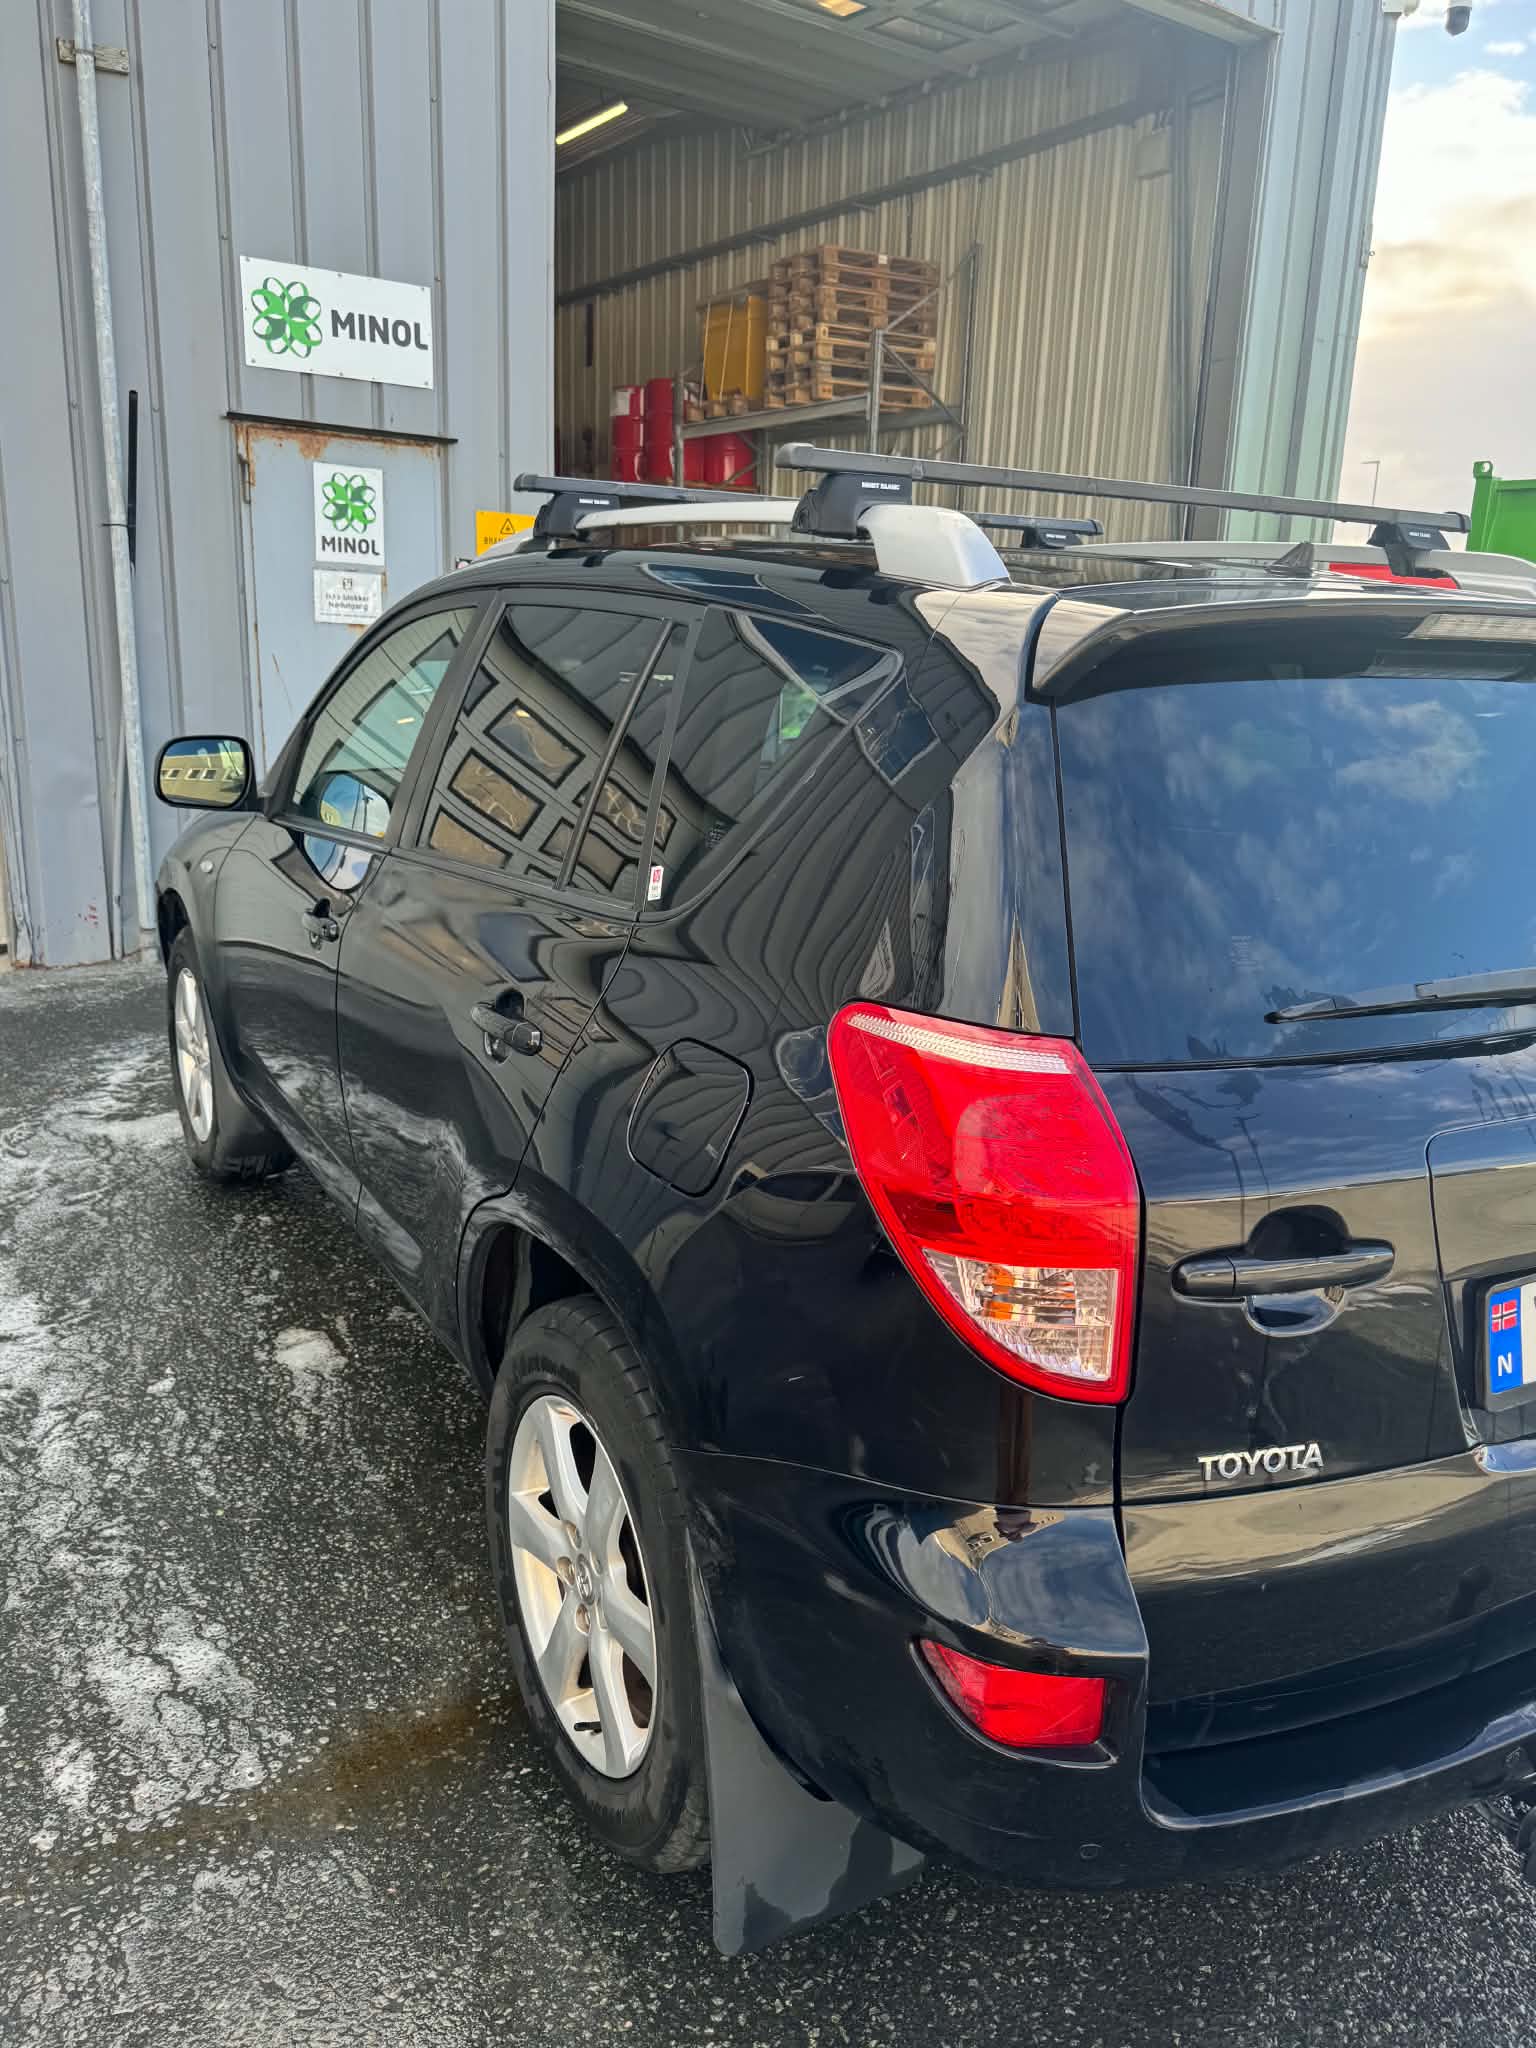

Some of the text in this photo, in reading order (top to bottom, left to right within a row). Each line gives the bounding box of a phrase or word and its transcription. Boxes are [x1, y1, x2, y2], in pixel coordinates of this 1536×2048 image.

[331, 309, 429, 351] MINOL
[321, 535, 380, 556] MINOL
[1497, 1351, 1513, 1377] N
[1198, 1441, 1325, 1481] TOYOTA
